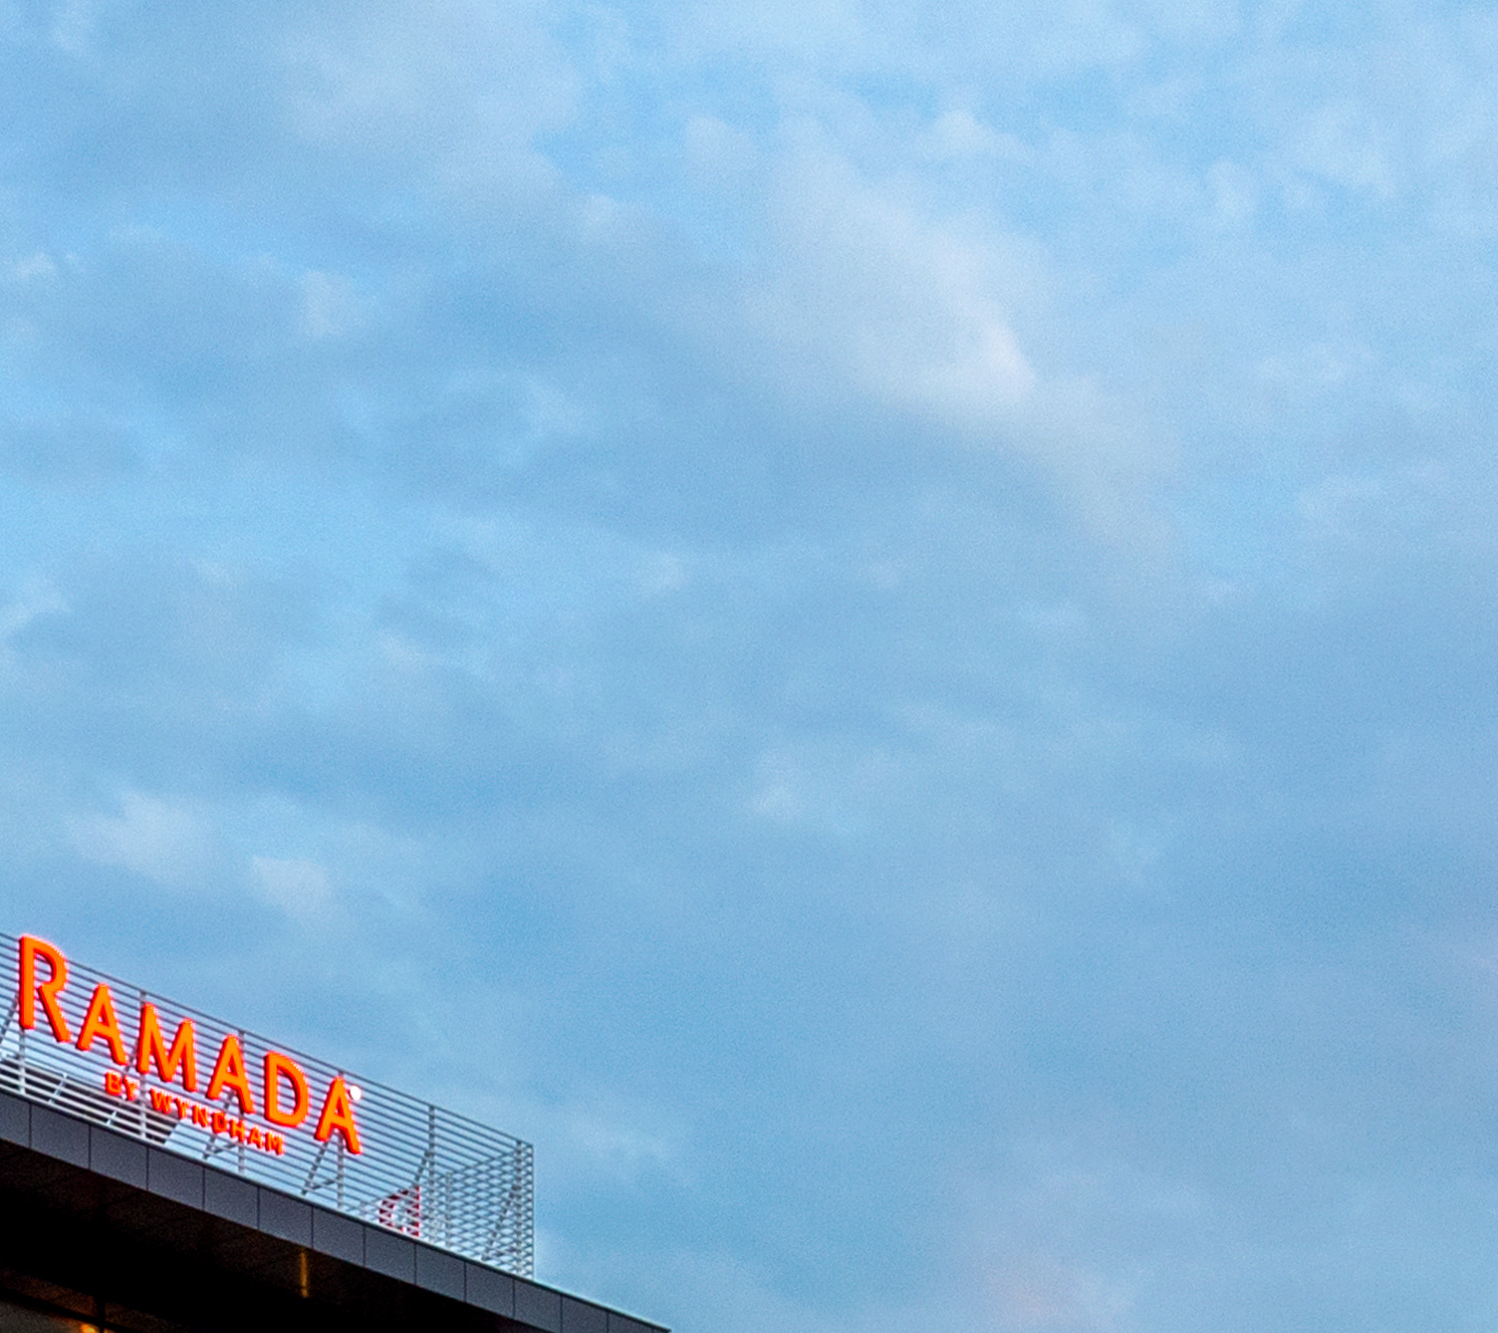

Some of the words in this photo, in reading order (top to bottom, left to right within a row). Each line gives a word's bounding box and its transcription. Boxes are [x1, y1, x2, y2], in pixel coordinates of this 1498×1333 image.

[18, 932, 364, 1155] RAMADA
[104, 1069, 138, 1101] BY
[149, 1086, 285, 1156] WYNDHAM
